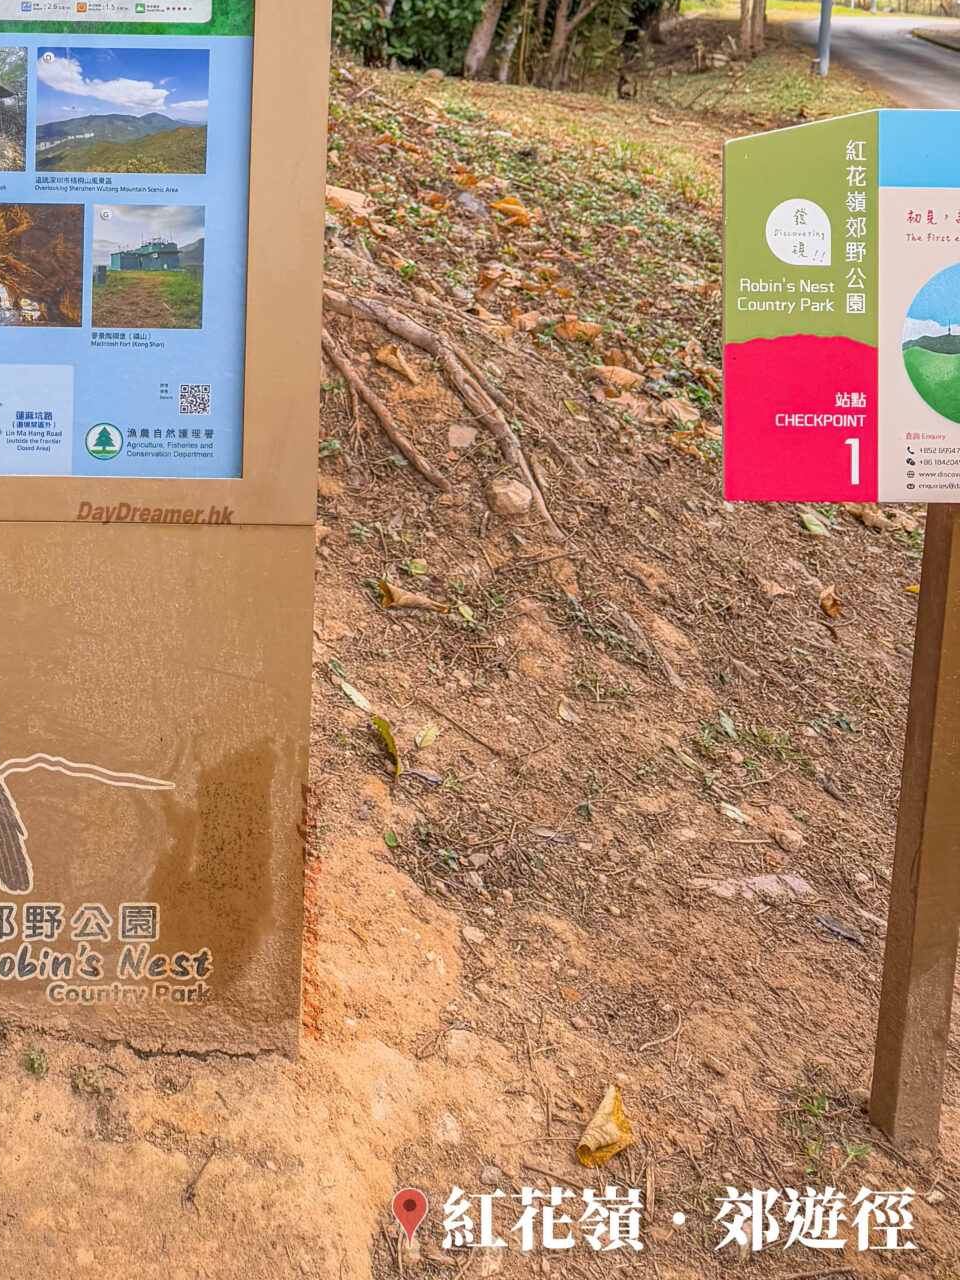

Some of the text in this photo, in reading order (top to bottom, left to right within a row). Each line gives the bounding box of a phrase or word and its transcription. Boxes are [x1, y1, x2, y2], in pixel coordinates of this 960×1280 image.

[773, 229, 825, 241] Discovering
[845, 139, 867, 315] 紅花嶺郊野公園
[906, 233, 951, 242] The first
[740, 277, 835, 294] Robin's Nest
[737, 298, 835, 314] Country Park
[835, 392, 867, 408] 站點
[775, 414, 867, 428] CHECKPOINT
[127, 428, 215, 439] 漁農自然護理署
[127, 442, 164, 450] Agriculture,
[173, 451, 214, 459] Department
[844, 438, 860, 485] 1
[118, 946, 214, 981] Nest
[48, 982, 212, 1006] Country Park
